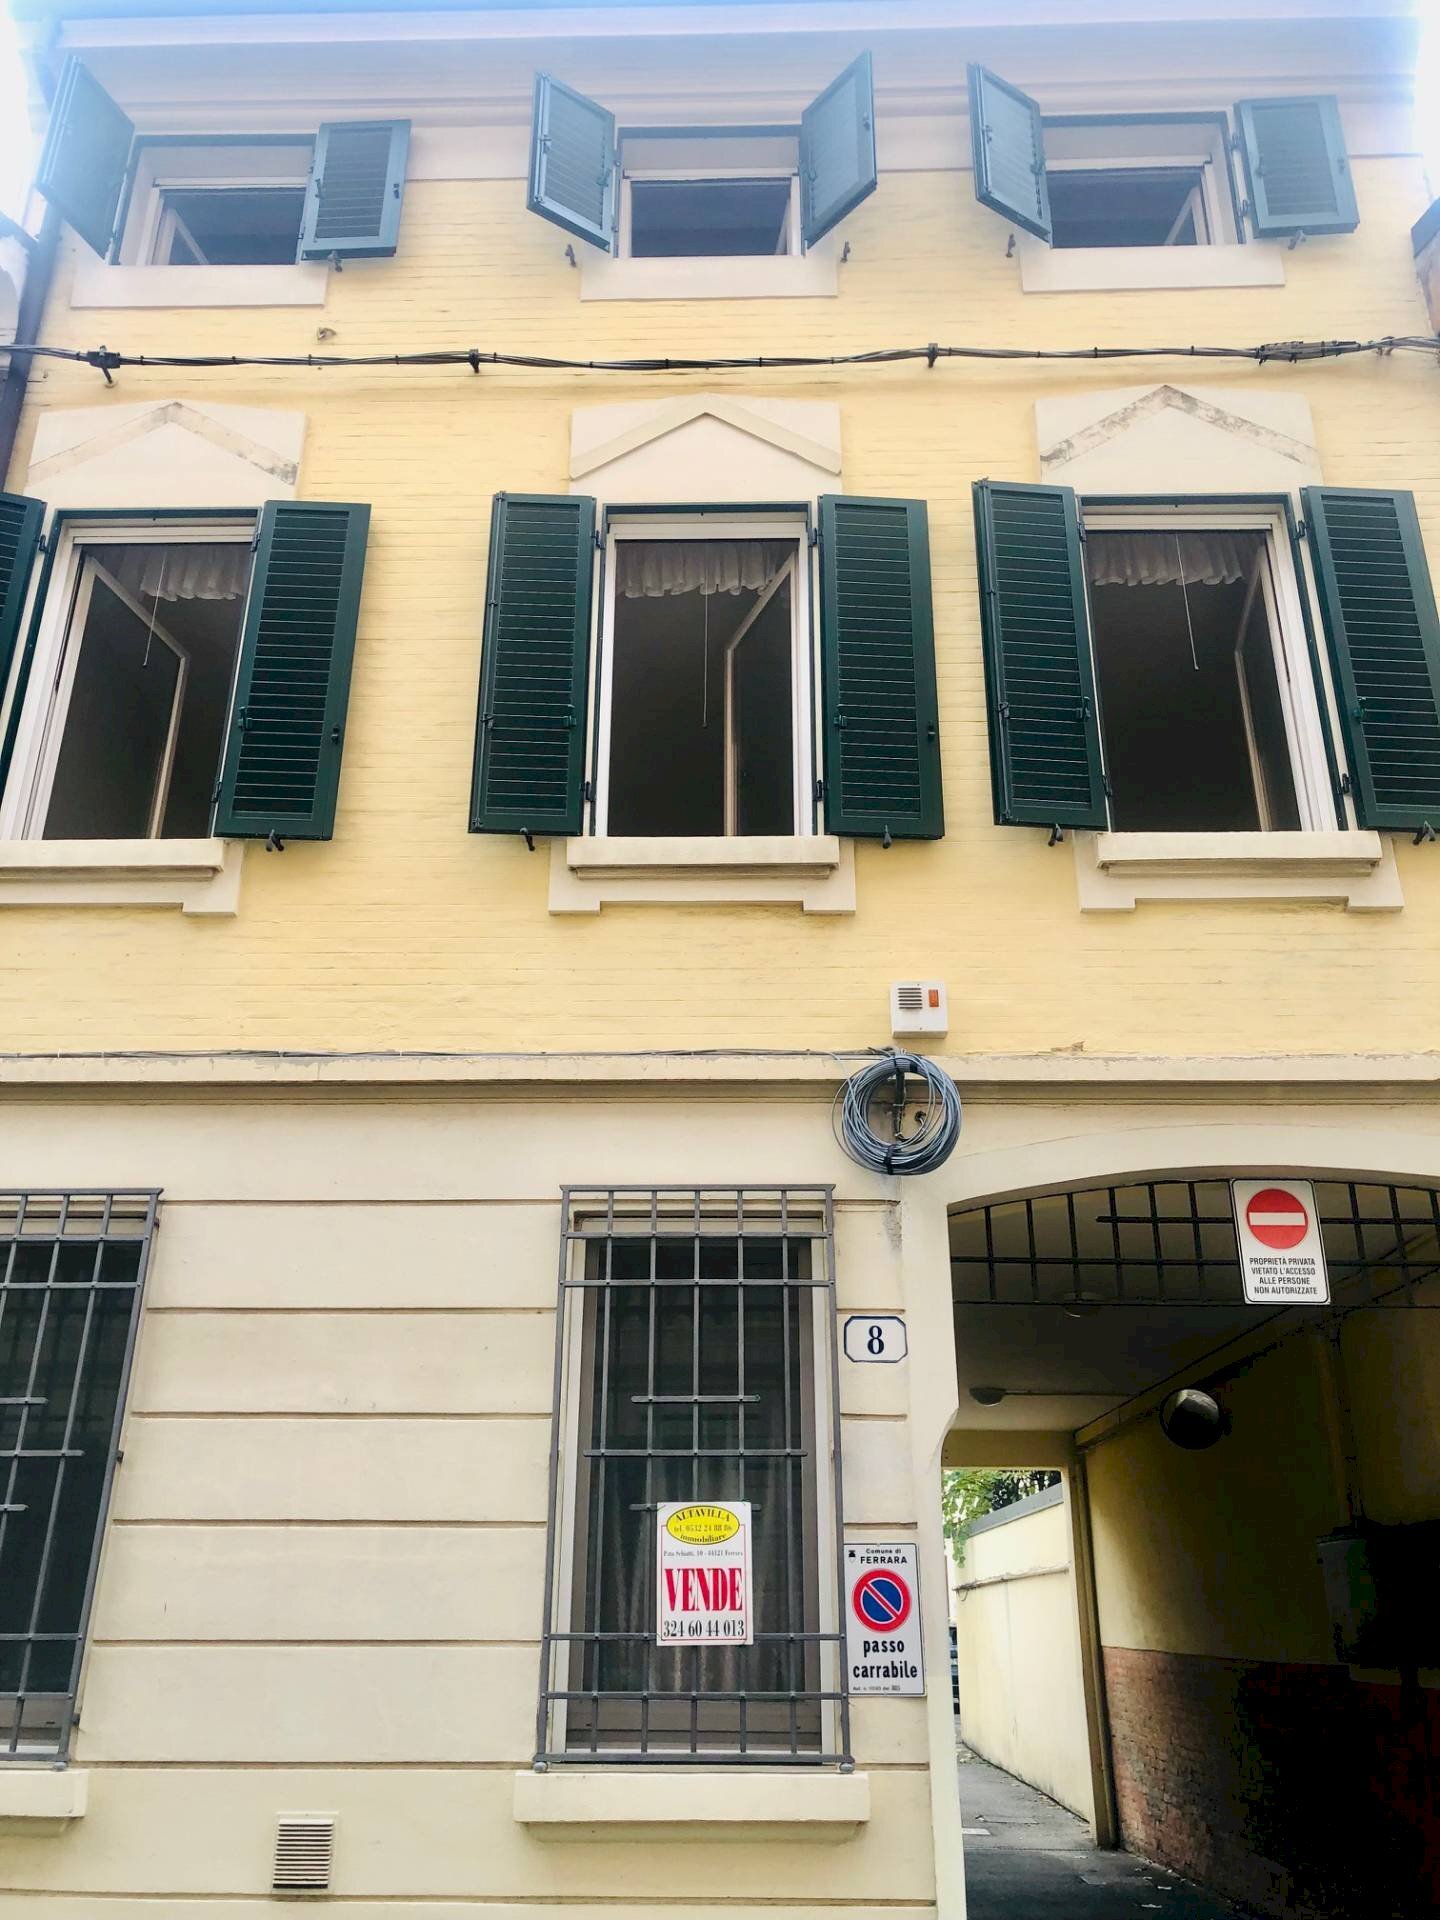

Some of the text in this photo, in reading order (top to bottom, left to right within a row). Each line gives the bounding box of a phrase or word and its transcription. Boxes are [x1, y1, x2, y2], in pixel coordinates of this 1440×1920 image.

[1249, 1256, 1316, 1266] PROPRIETÀ PRIVATA
[1251, 1267, 1316, 1275] VIETATO L'ACCESSO
[1259, 1276, 1311, 1285] ALLE PERSONE
[1254, 1286, 1318, 1295] NON AUTORIZZATE
[867, 1325, 885, 1355] 8
[675, 1508, 731, 1522] ALTAVILLA
[680, 1534, 727, 1543] immobiliare
[860, 1556, 908, 1564] FERRARA
[664, 1567, 743, 1612] VENDE
[663, 1620, 745, 1637] 324 60 44 013
[863, 1640, 905, 1658] passo
[853, 1660, 918, 1678] carrabile
